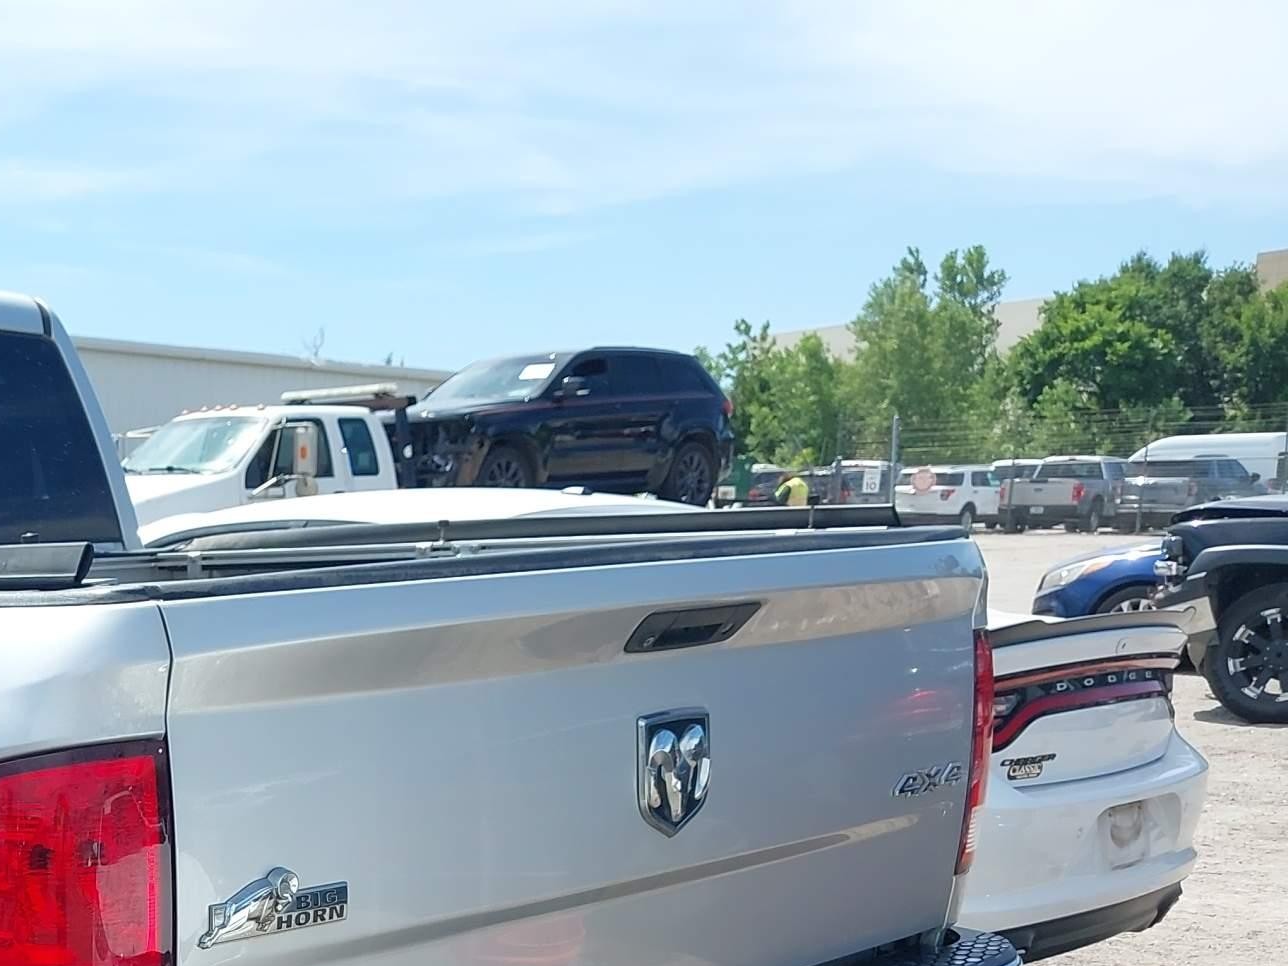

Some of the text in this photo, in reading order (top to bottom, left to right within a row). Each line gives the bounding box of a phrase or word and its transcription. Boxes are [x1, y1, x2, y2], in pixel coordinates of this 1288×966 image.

[1055, 670, 1154, 692] DODGE
[295, 888, 339, 910] BIG
[276, 904, 346, 930] HORN
